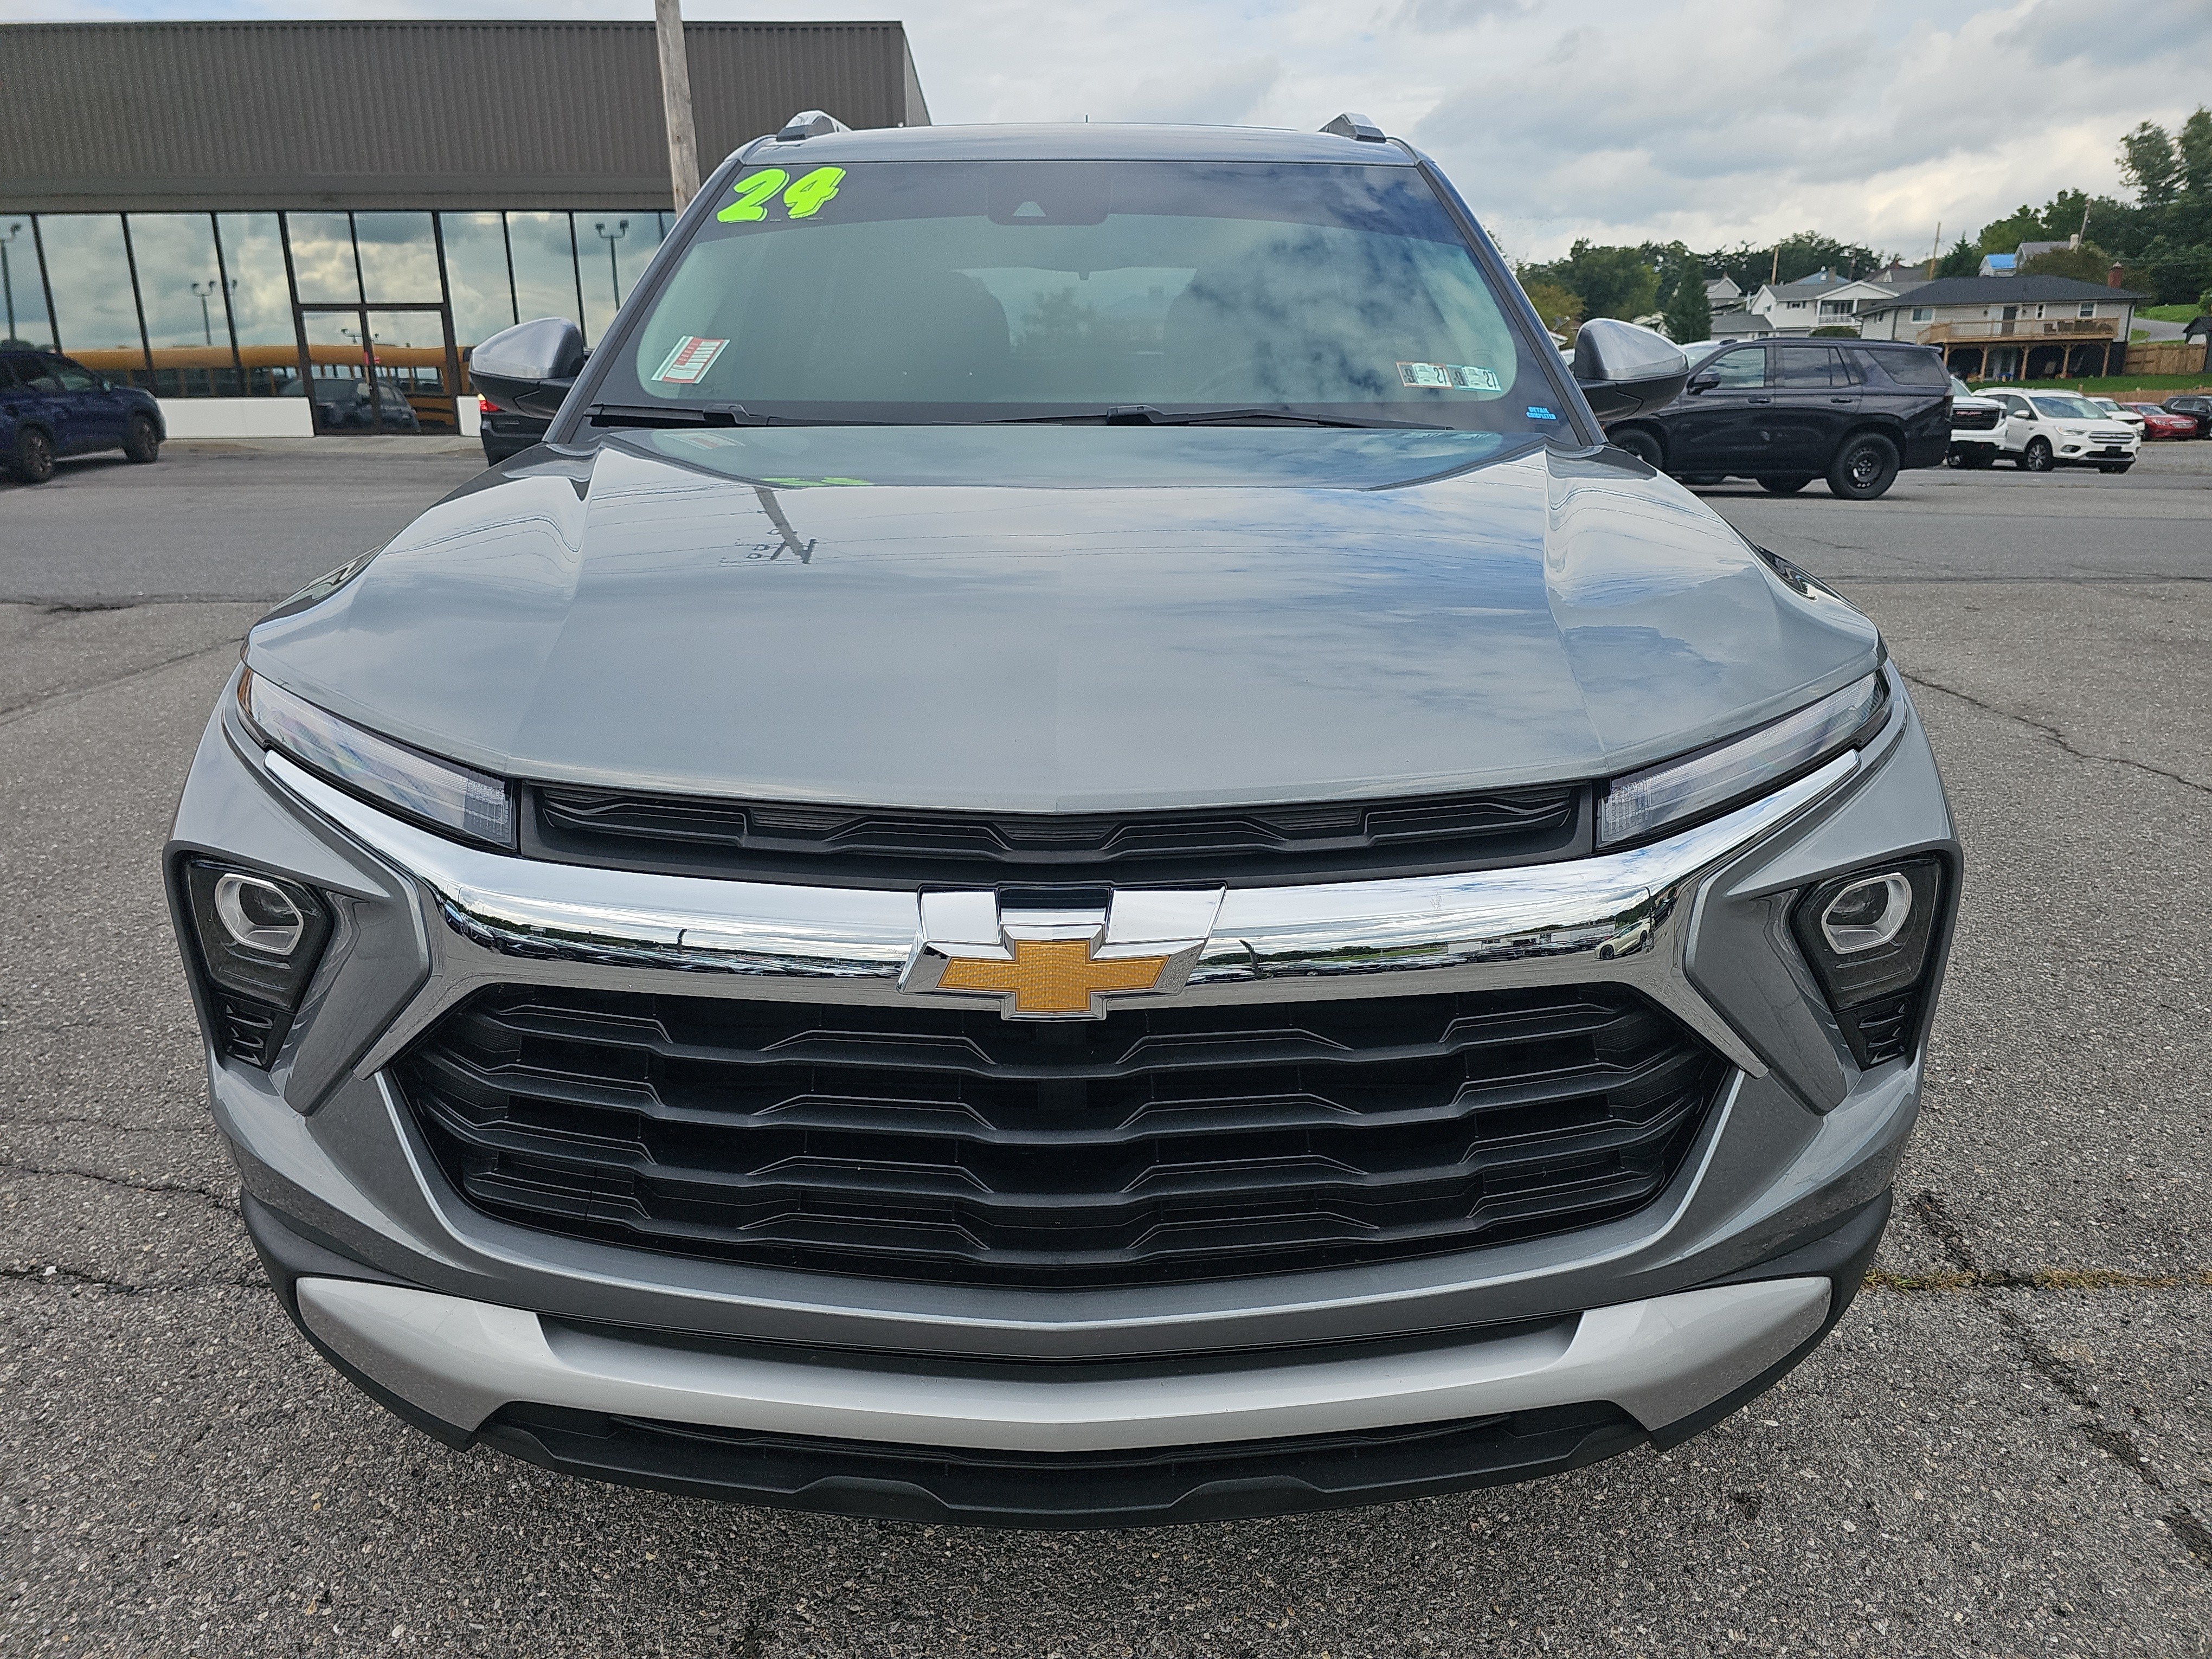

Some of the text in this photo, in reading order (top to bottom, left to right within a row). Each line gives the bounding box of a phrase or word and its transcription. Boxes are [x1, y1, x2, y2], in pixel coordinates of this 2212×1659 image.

[717, 166, 847, 223] 24
[1433, 367, 1447, 385] 27
[1483, 371, 1496, 389] 27
